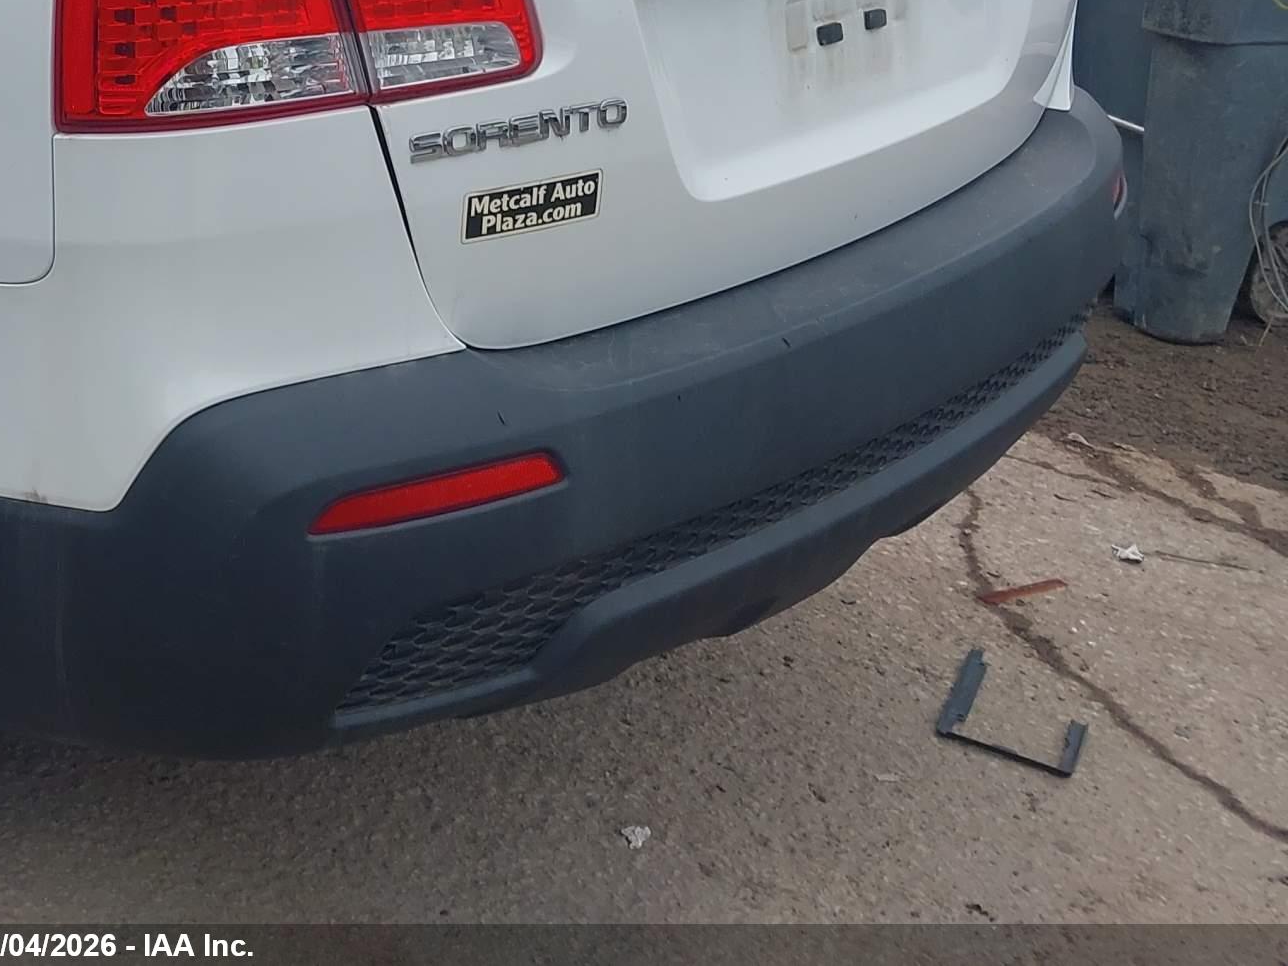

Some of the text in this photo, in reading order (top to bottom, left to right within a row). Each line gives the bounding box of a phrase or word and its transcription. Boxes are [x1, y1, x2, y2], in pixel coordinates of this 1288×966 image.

[409, 98, 628, 163] SORENTO
[470, 179, 596, 217] Metcalf Auto
[481, 201, 582, 235] Plaza.com
